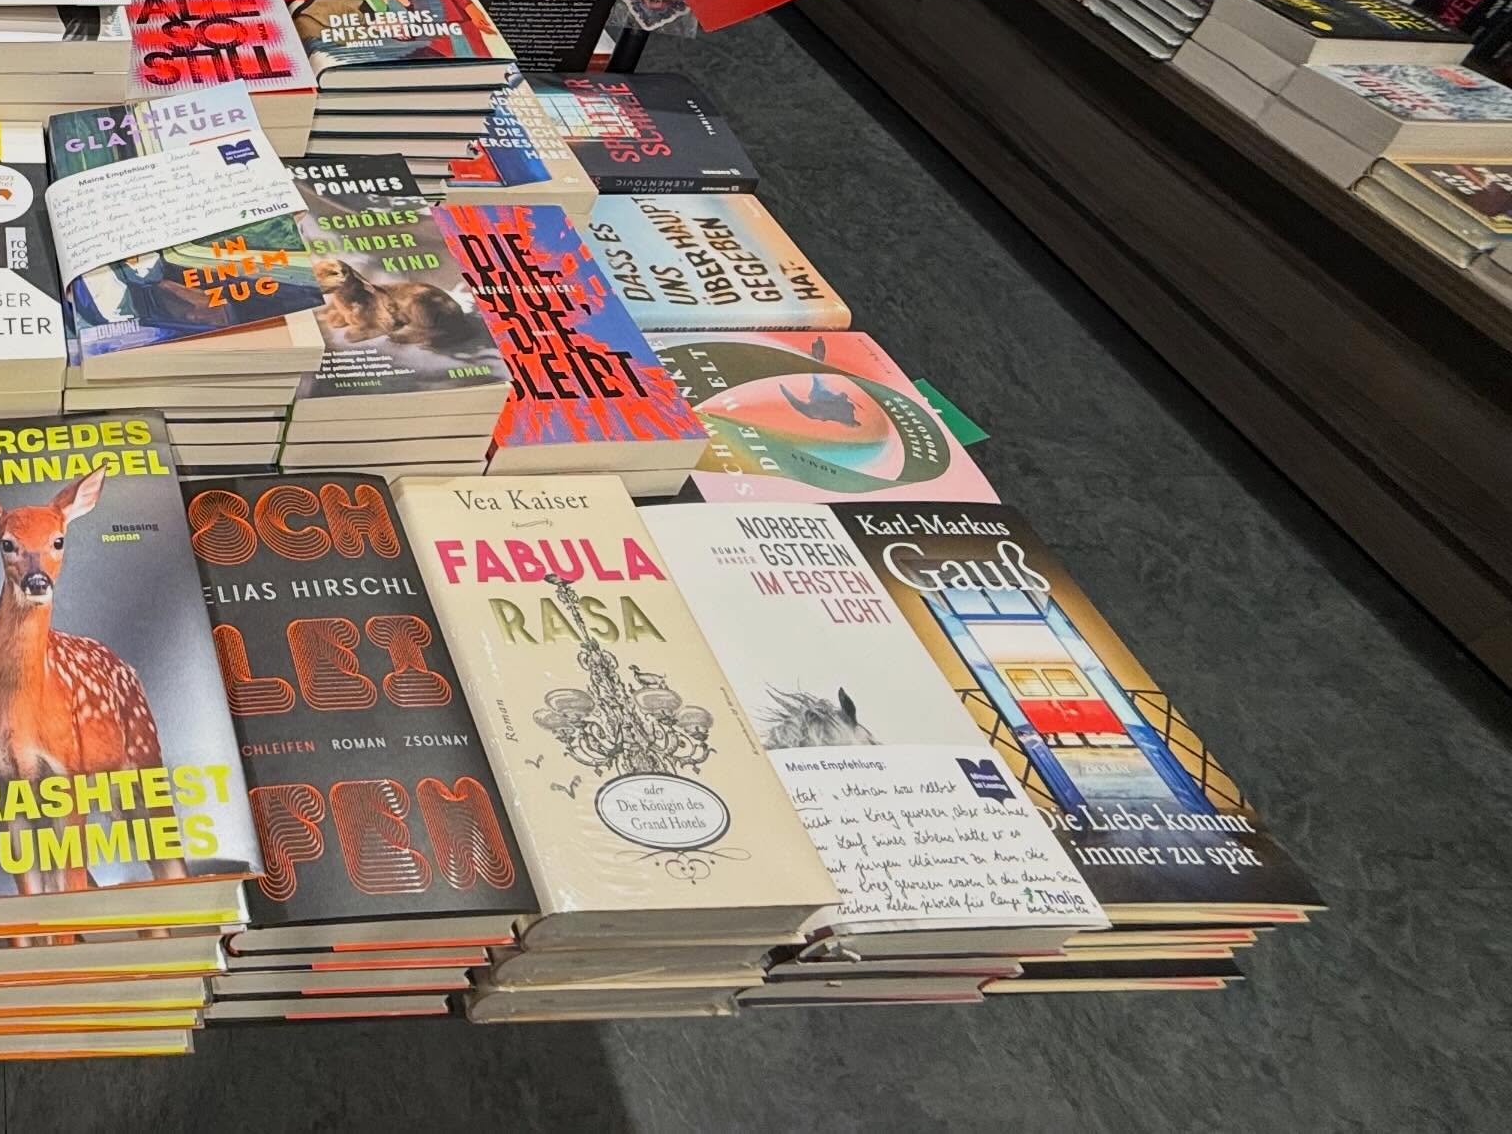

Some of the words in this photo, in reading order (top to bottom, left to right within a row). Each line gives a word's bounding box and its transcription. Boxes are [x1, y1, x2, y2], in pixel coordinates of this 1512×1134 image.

[329, 14, 363, 28] DIE
[365, 9, 439, 27] LEBENS-
[321, 23, 463, 43] ENTSCHEIDUNG
[142, 45, 293, 86] STILL
[96, 102, 207, 132] DANIEL
[65, 108, 248, 153] GLATTAUER
[78, 174, 106, 187] Meine
[313, 176, 404, 197] POMMES
[249, 202, 290, 218] Thalia
[316, 209, 420, 232] SCHÖNES
[589, 222, 621, 243] ES
[211, 235, 248, 259] IN
[458, 232, 532, 266] DIE
[182, 249, 291, 290] EINEM
[382, 253, 441, 273] KIND
[692, 217, 786, 304] GEGEBEN
[604, 247, 655, 303] DASS
[649, 263, 699, 307] UNS
[204, 276, 280, 309] ZUG
[499, 310, 580, 356] DIE
[447, 365, 492, 379] ROMAN
[506, 350, 651, 403] BLEIBT
[454, 490, 503, 511] Vea
[511, 490, 590, 512] Kaiser
[101, 531, 141, 543] Roman
[735, 515, 835, 542] NORBERT
[854, 514, 1011, 537] Karl-Markus
[434, 537, 669, 585] FABULA
[710, 546, 748, 556] ROMAN
[716, 555, 758, 566] HANSER
[758, 543, 858, 567] GSTREIN
[882, 540, 1052, 595] Gauß
[202, 581, 278, 605] ELIAS
[291, 576, 418, 600] HIRSCHL
[749, 570, 787, 596] IM
[787, 569, 876, 596] ERSTEN
[488, 595, 668, 645] RASA
[819, 598, 892, 626] LICHT
[494, 698, 520, 744] Roman
[331, 736, 387, 751] ROMAN
[403, 733, 470, 748] ZSOLNAY
[785, 760, 819, 774] Meine
[820, 759, 888, 774] Empfehlung:
[643, 784, 666, 797] oder
[616, 797, 638, 813] Die
[639, 796, 684, 817] Königin
[686, 797, 706, 813] des
[630, 815, 664, 832] Grand
[665, 815, 707, 832] Hotels
[1084, 803, 1158, 835] Liebe
[1166, 808, 1257, 836] kommt
[1070, 841, 1170, 867] immer
[1174, 846, 1204, 867] zu
[1208, 839, 1264, 876] spät
[1038, 888, 1086, 906] Thalia
